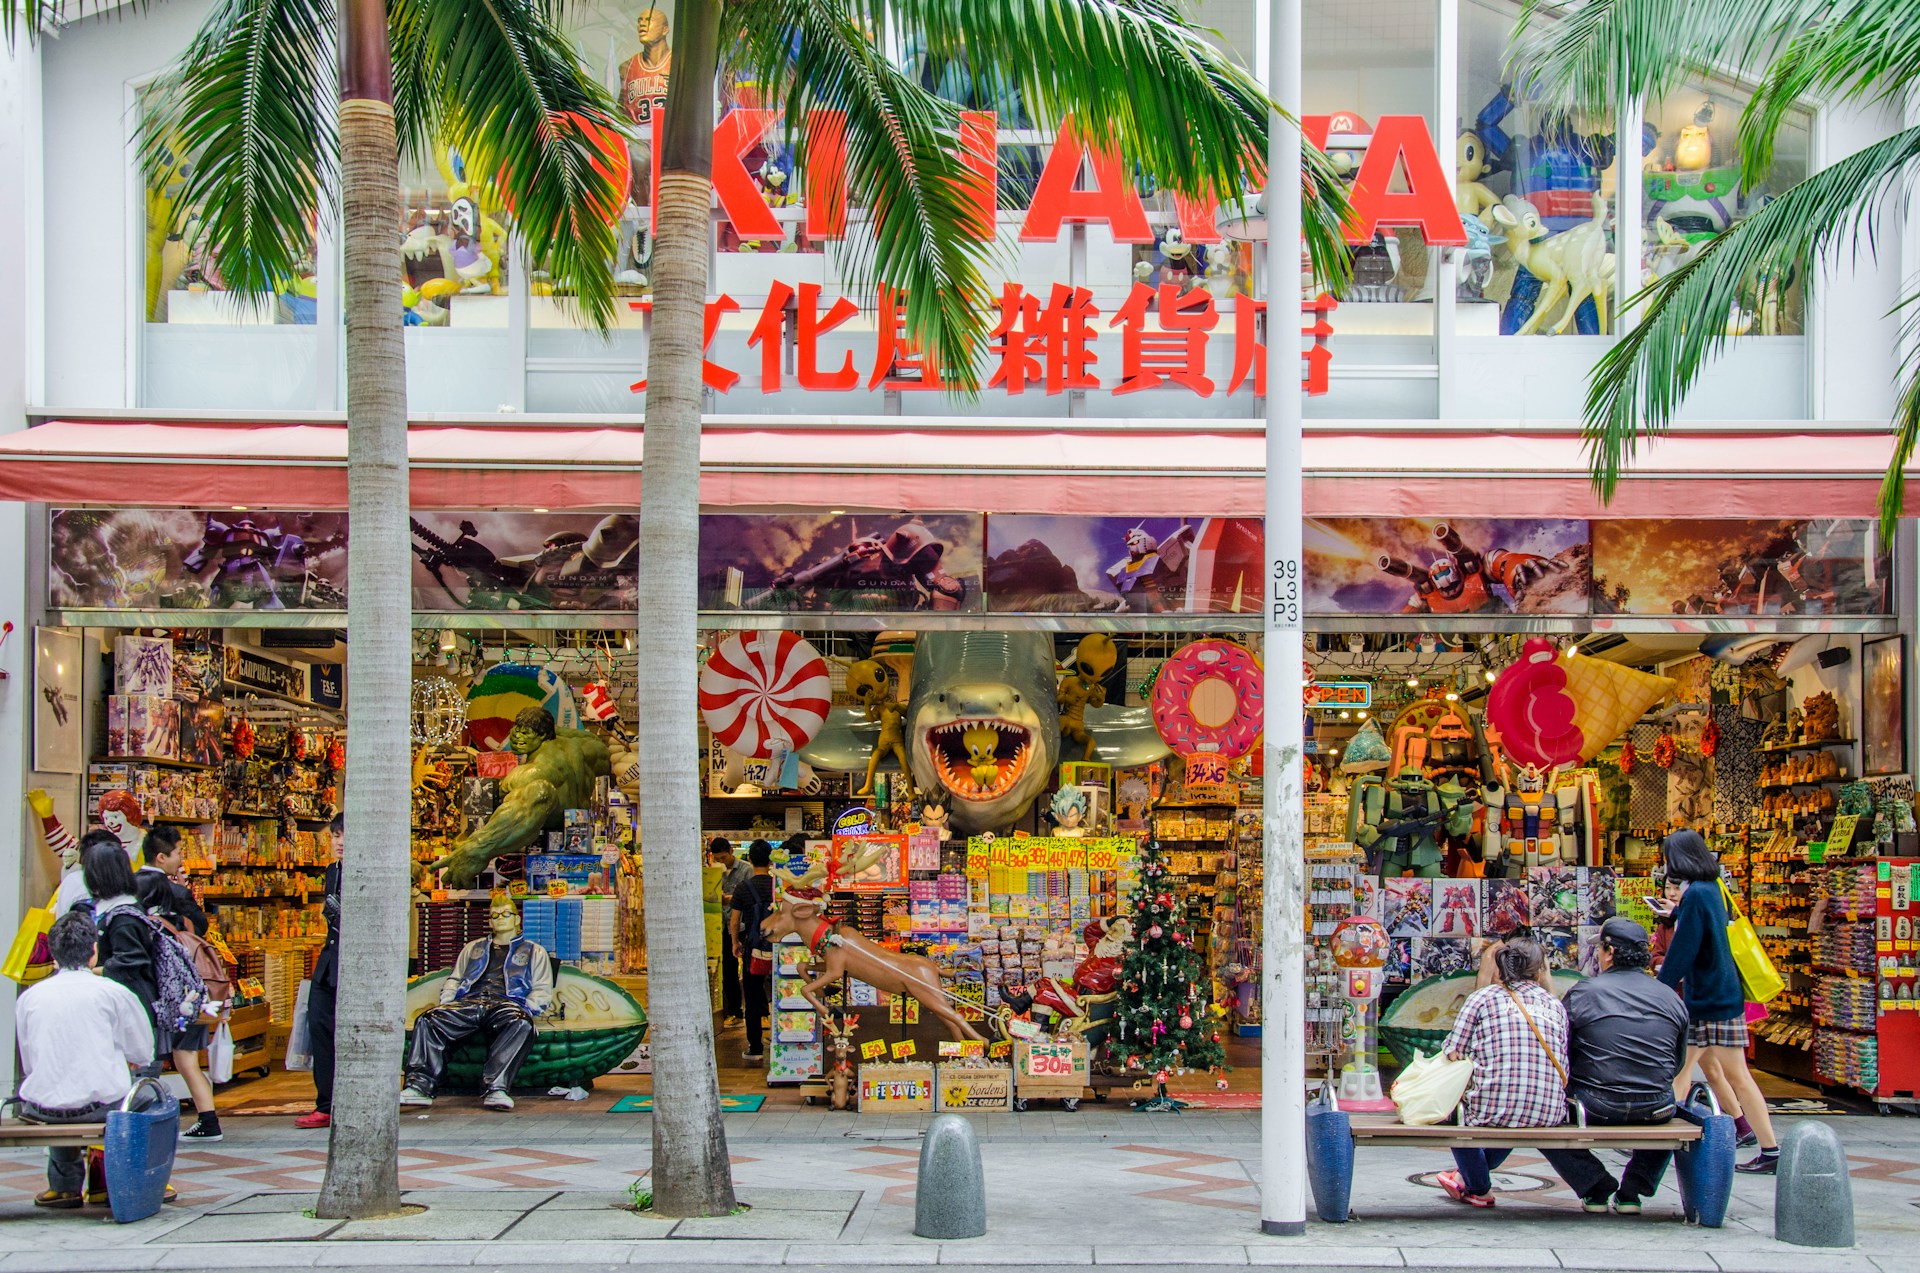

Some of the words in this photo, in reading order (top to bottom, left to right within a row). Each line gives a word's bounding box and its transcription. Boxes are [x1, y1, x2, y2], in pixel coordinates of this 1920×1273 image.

[1273, 560, 1297, 579] 39
[1274, 581, 1297, 600] L3
[1273, 603, 1298, 622] P3
[838, 813, 866, 828] COLD
[865, 1085, 886, 1097] LIFE
[890, 1085, 929, 1097] SAVERS
[967, 1083, 1005, 1095] Borden's
